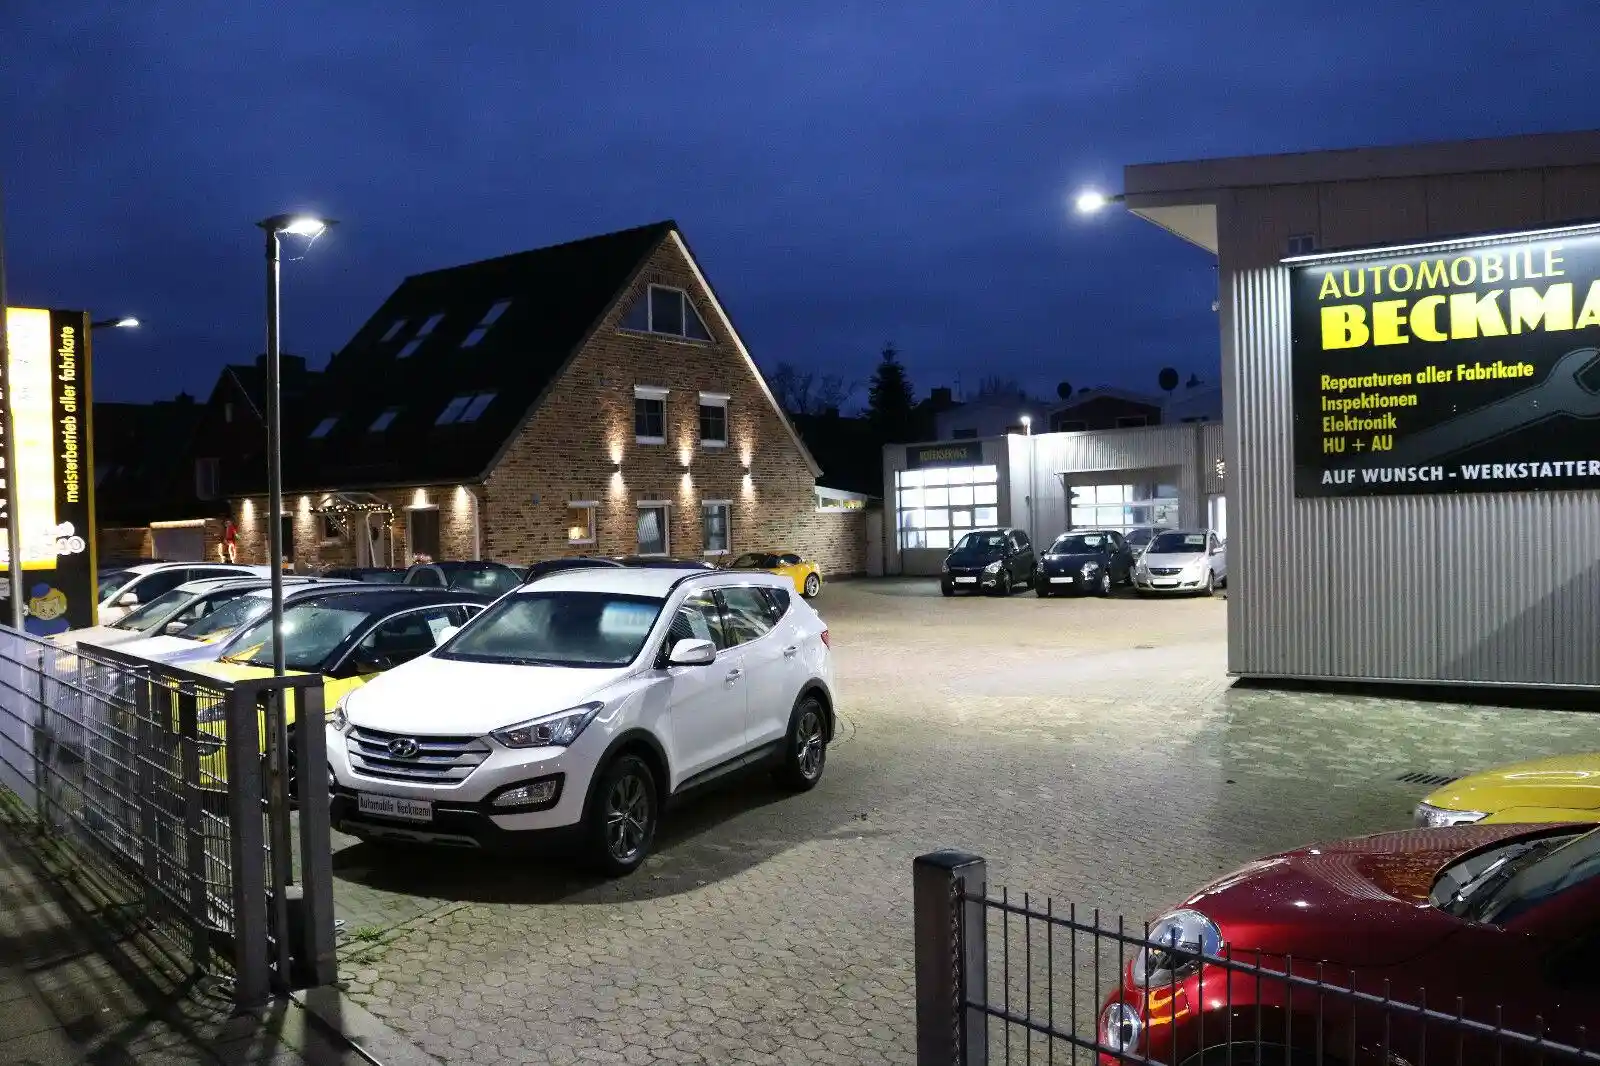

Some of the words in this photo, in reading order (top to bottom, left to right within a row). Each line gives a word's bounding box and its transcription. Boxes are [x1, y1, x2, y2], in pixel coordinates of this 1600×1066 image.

[1318, 243, 1565, 300] AUTOMOBILE
[58, 326, 75, 381] fabrikate
[1321, 372, 1412, 393] Reparaturen
[1416, 366, 1452, 384] aller
[1457, 360, 1534, 382] Fabrikate
[59, 384, 76, 412] aller
[1321, 393, 1418, 414] Inspektionen
[1323, 412, 1398, 433] Elektronik
[1323, 437, 1346, 453] HU
[1351, 441, 1366, 453] +
[1371, 434, 1394, 451] AU
[60, 415, 79, 502] meisterbetrieb
[1321, 469, 1357, 485] AUF
[1361, 465, 1444, 483] WUNSCH
[1461, 460, 1600, 481] WERKSTATTER
[360, 796, 394, 813] Automobile
